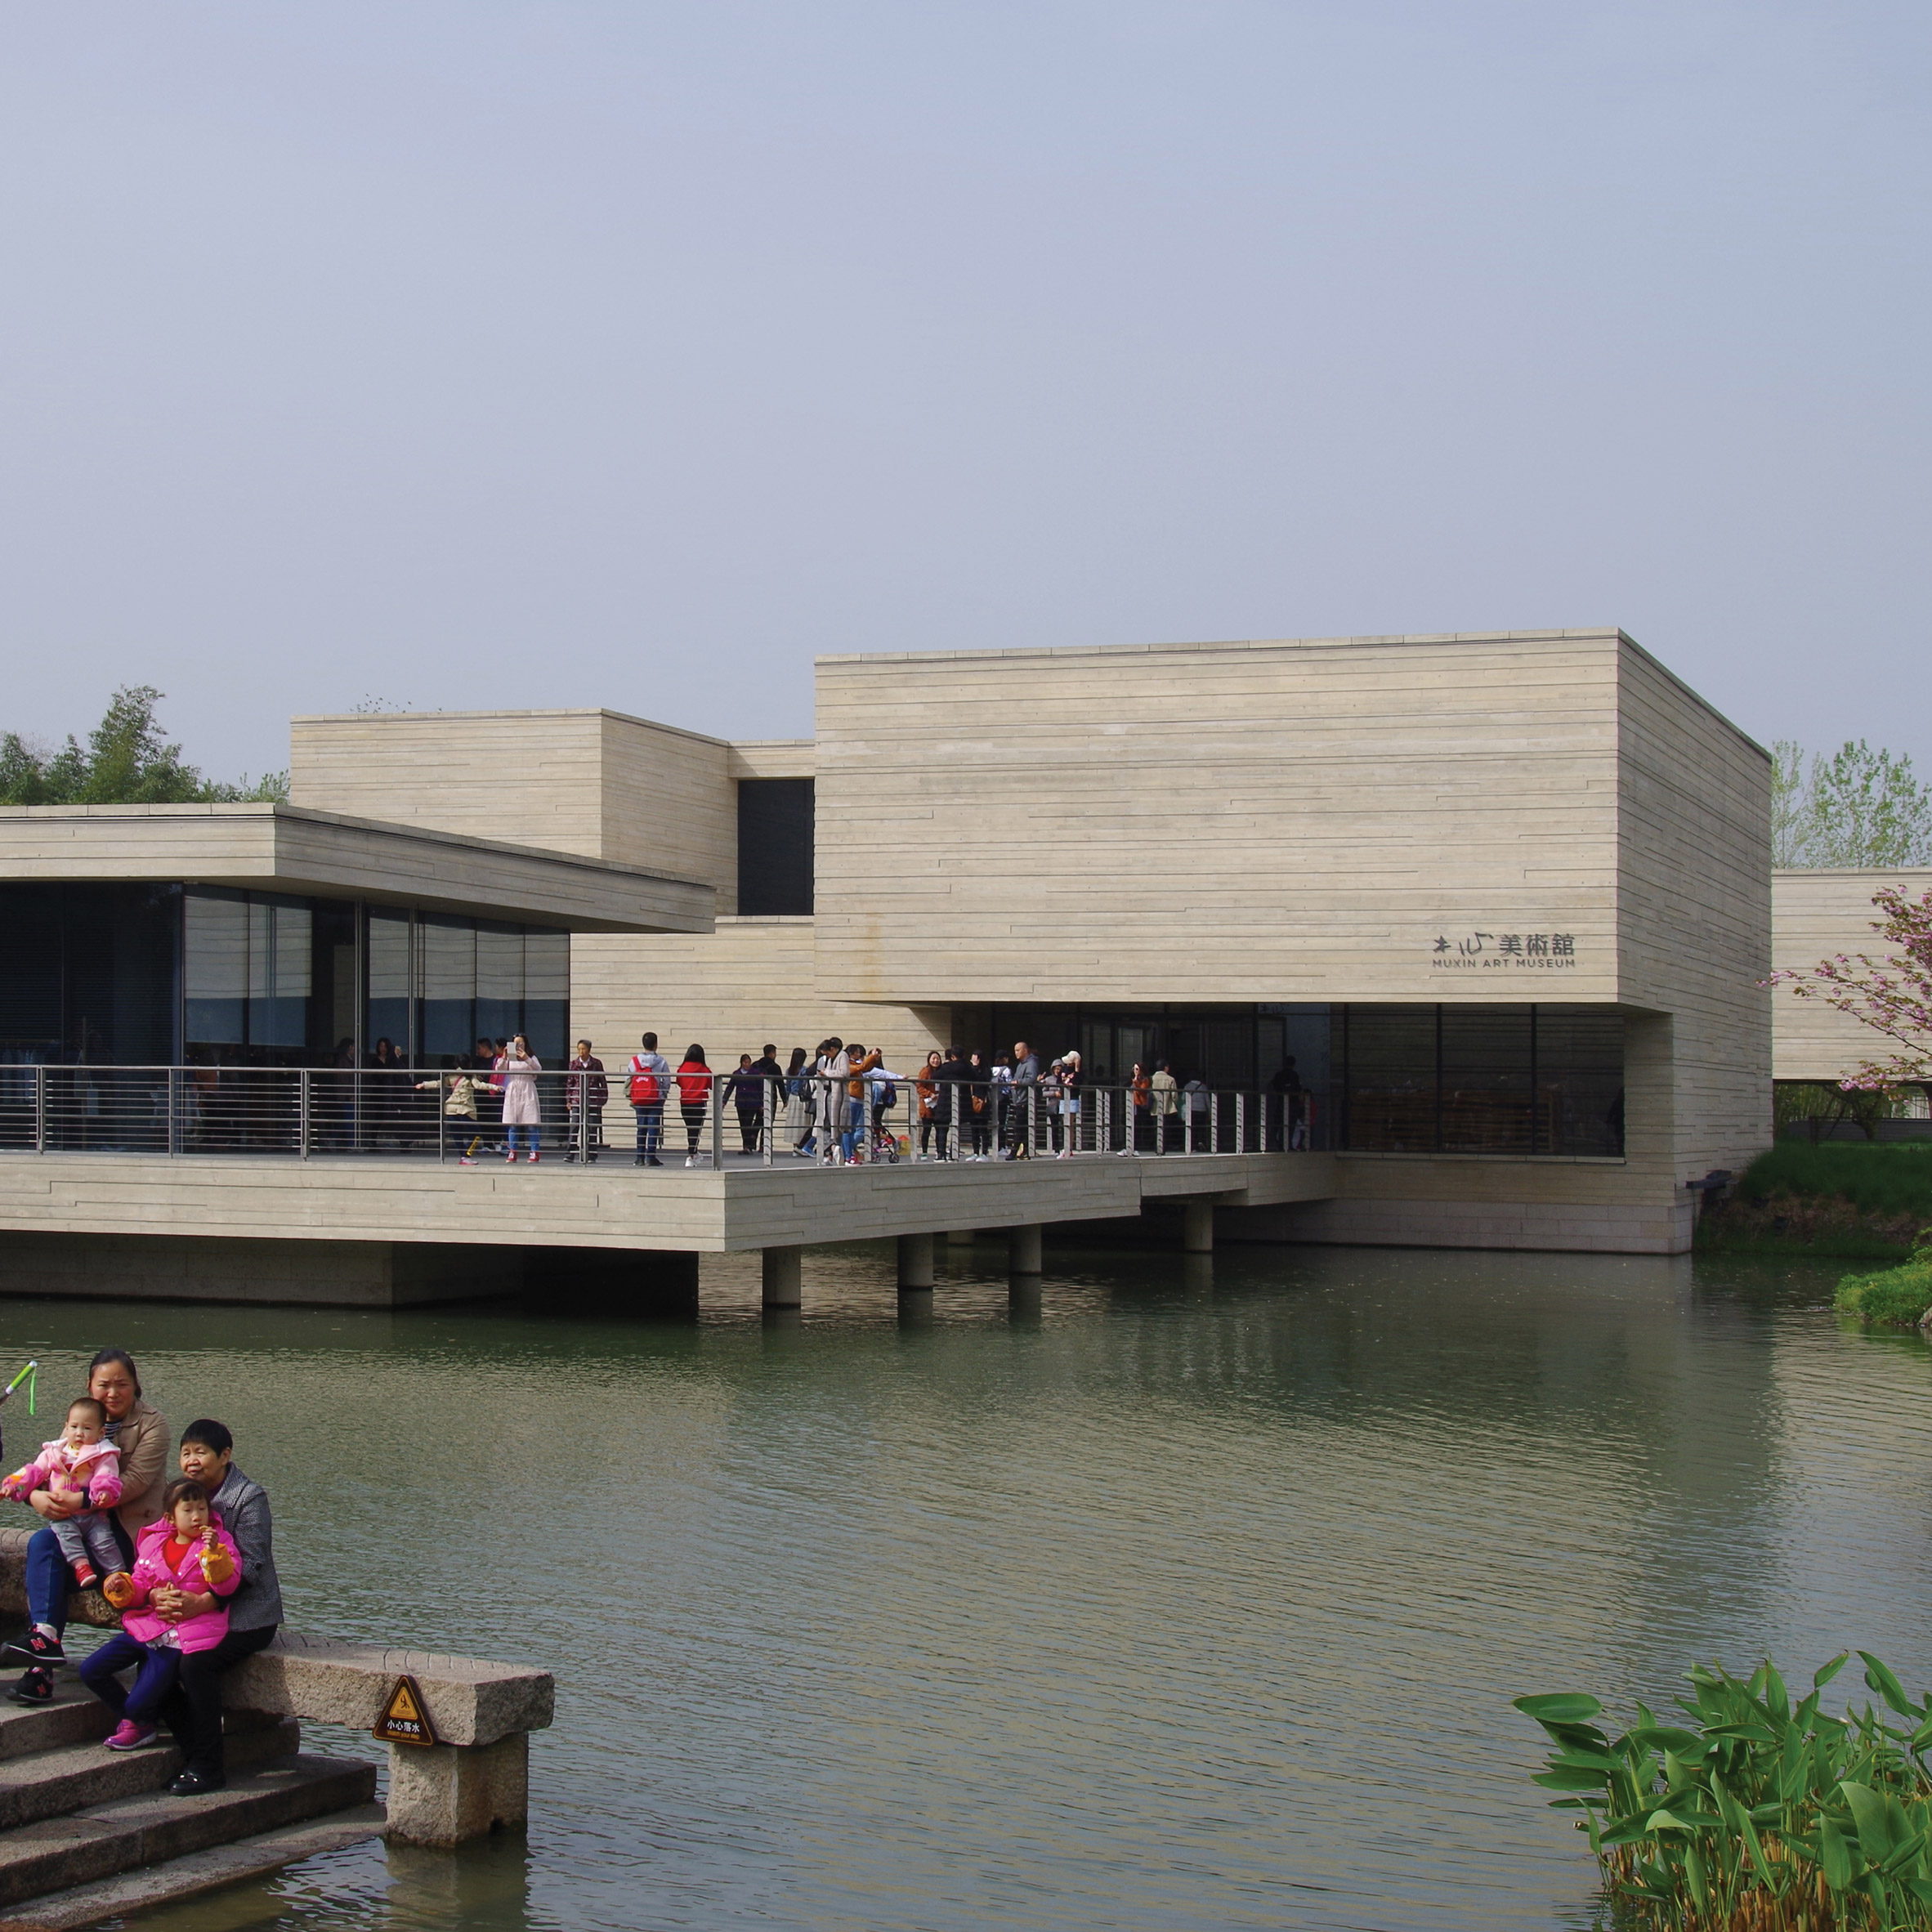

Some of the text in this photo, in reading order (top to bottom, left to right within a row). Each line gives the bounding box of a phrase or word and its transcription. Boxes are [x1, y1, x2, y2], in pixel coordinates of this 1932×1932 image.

[1433, 959, 1575, 968] MUXIN ART MUSEUM
[30, 1637, 47, 1651] N
[37, 1684, 47, 1696] N
[387, 1719, 420, 1733] 小心落水
